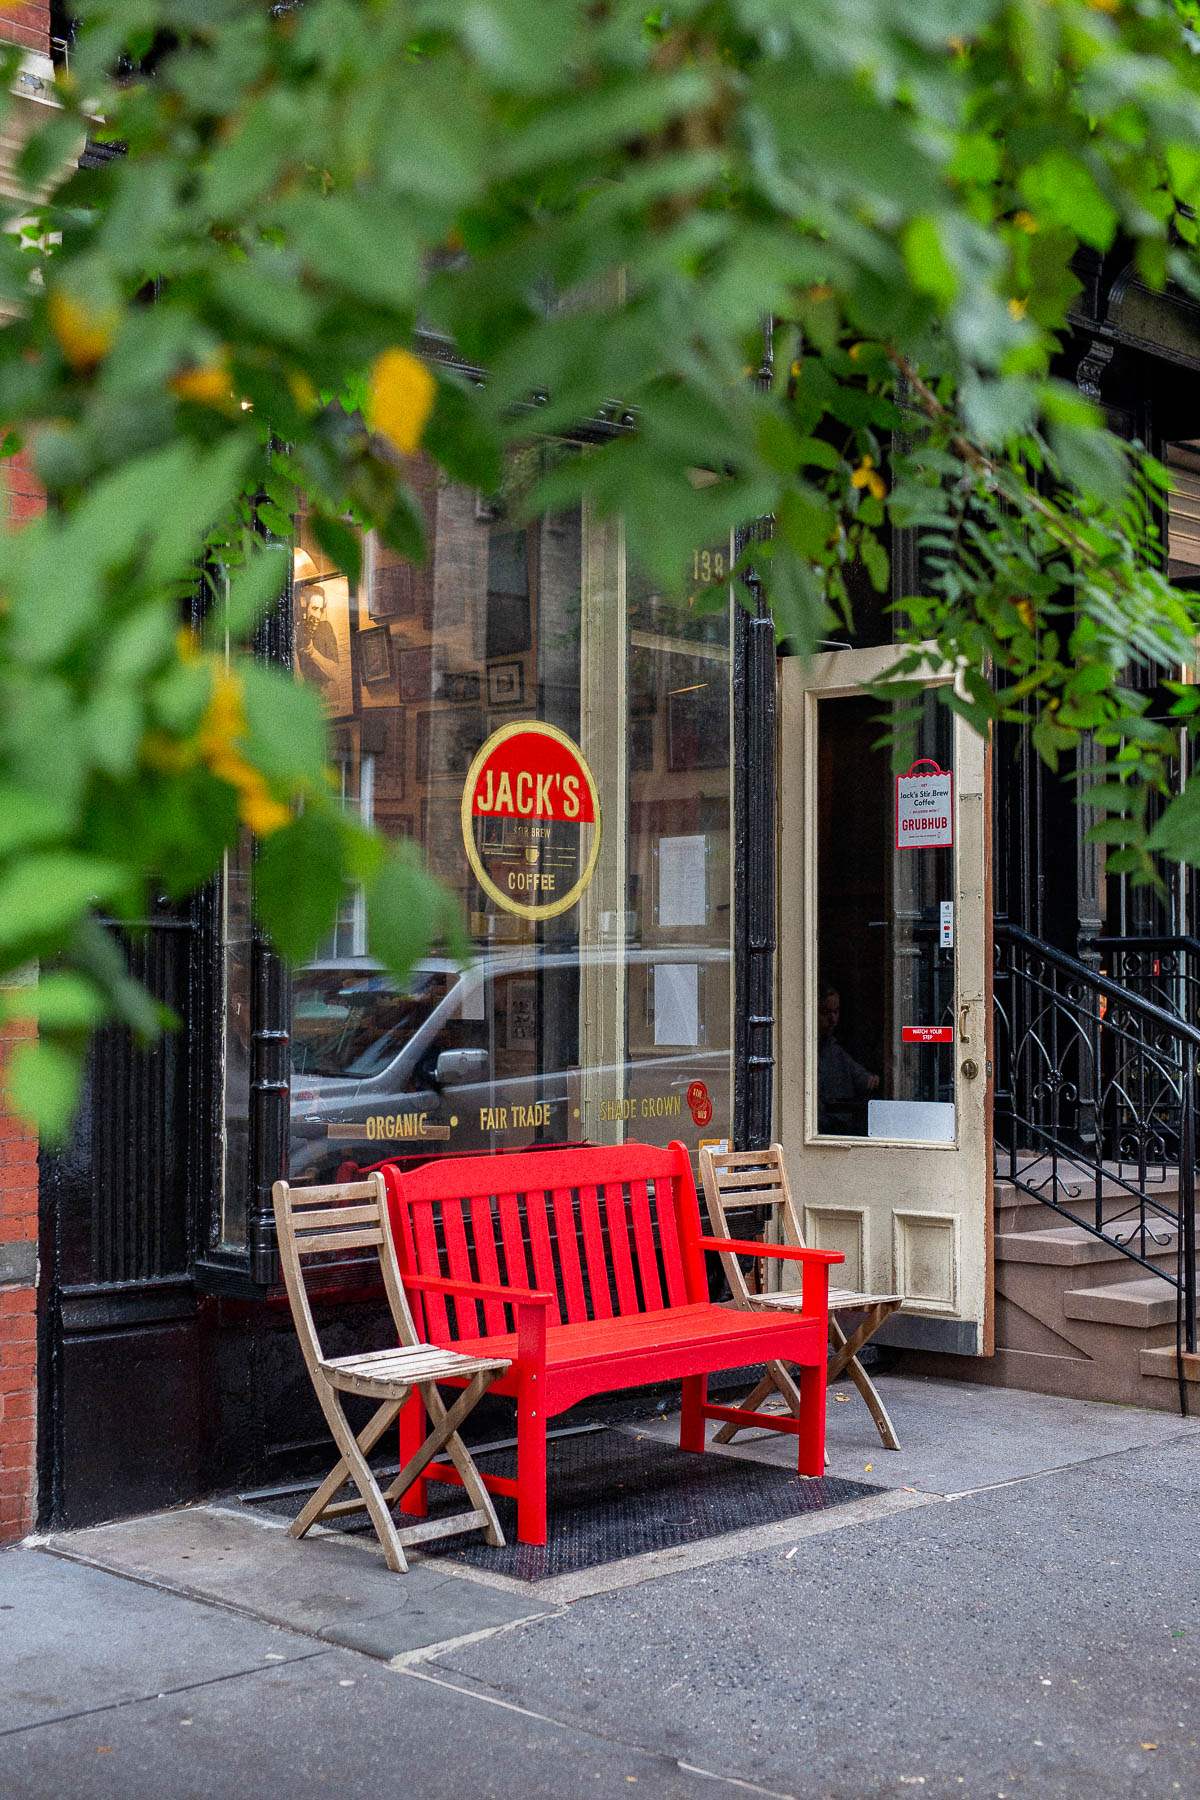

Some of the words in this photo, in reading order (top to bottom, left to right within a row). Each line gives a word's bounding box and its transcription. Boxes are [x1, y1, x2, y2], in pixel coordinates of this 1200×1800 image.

[477, 769, 580, 818] JACK'S
[531, 827, 551, 839] BREW
[902, 816, 948, 831] GRUBHUB
[508, 871, 556, 891] COFFEE
[366, 1112, 428, 1140] ORGANIC
[480, 1107, 508, 1131] FAIR
[511, 1104, 551, 1128] TRADE
[600, 1098, 638, 1121] SHADE
[641, 1095, 681, 1118] GROWN
